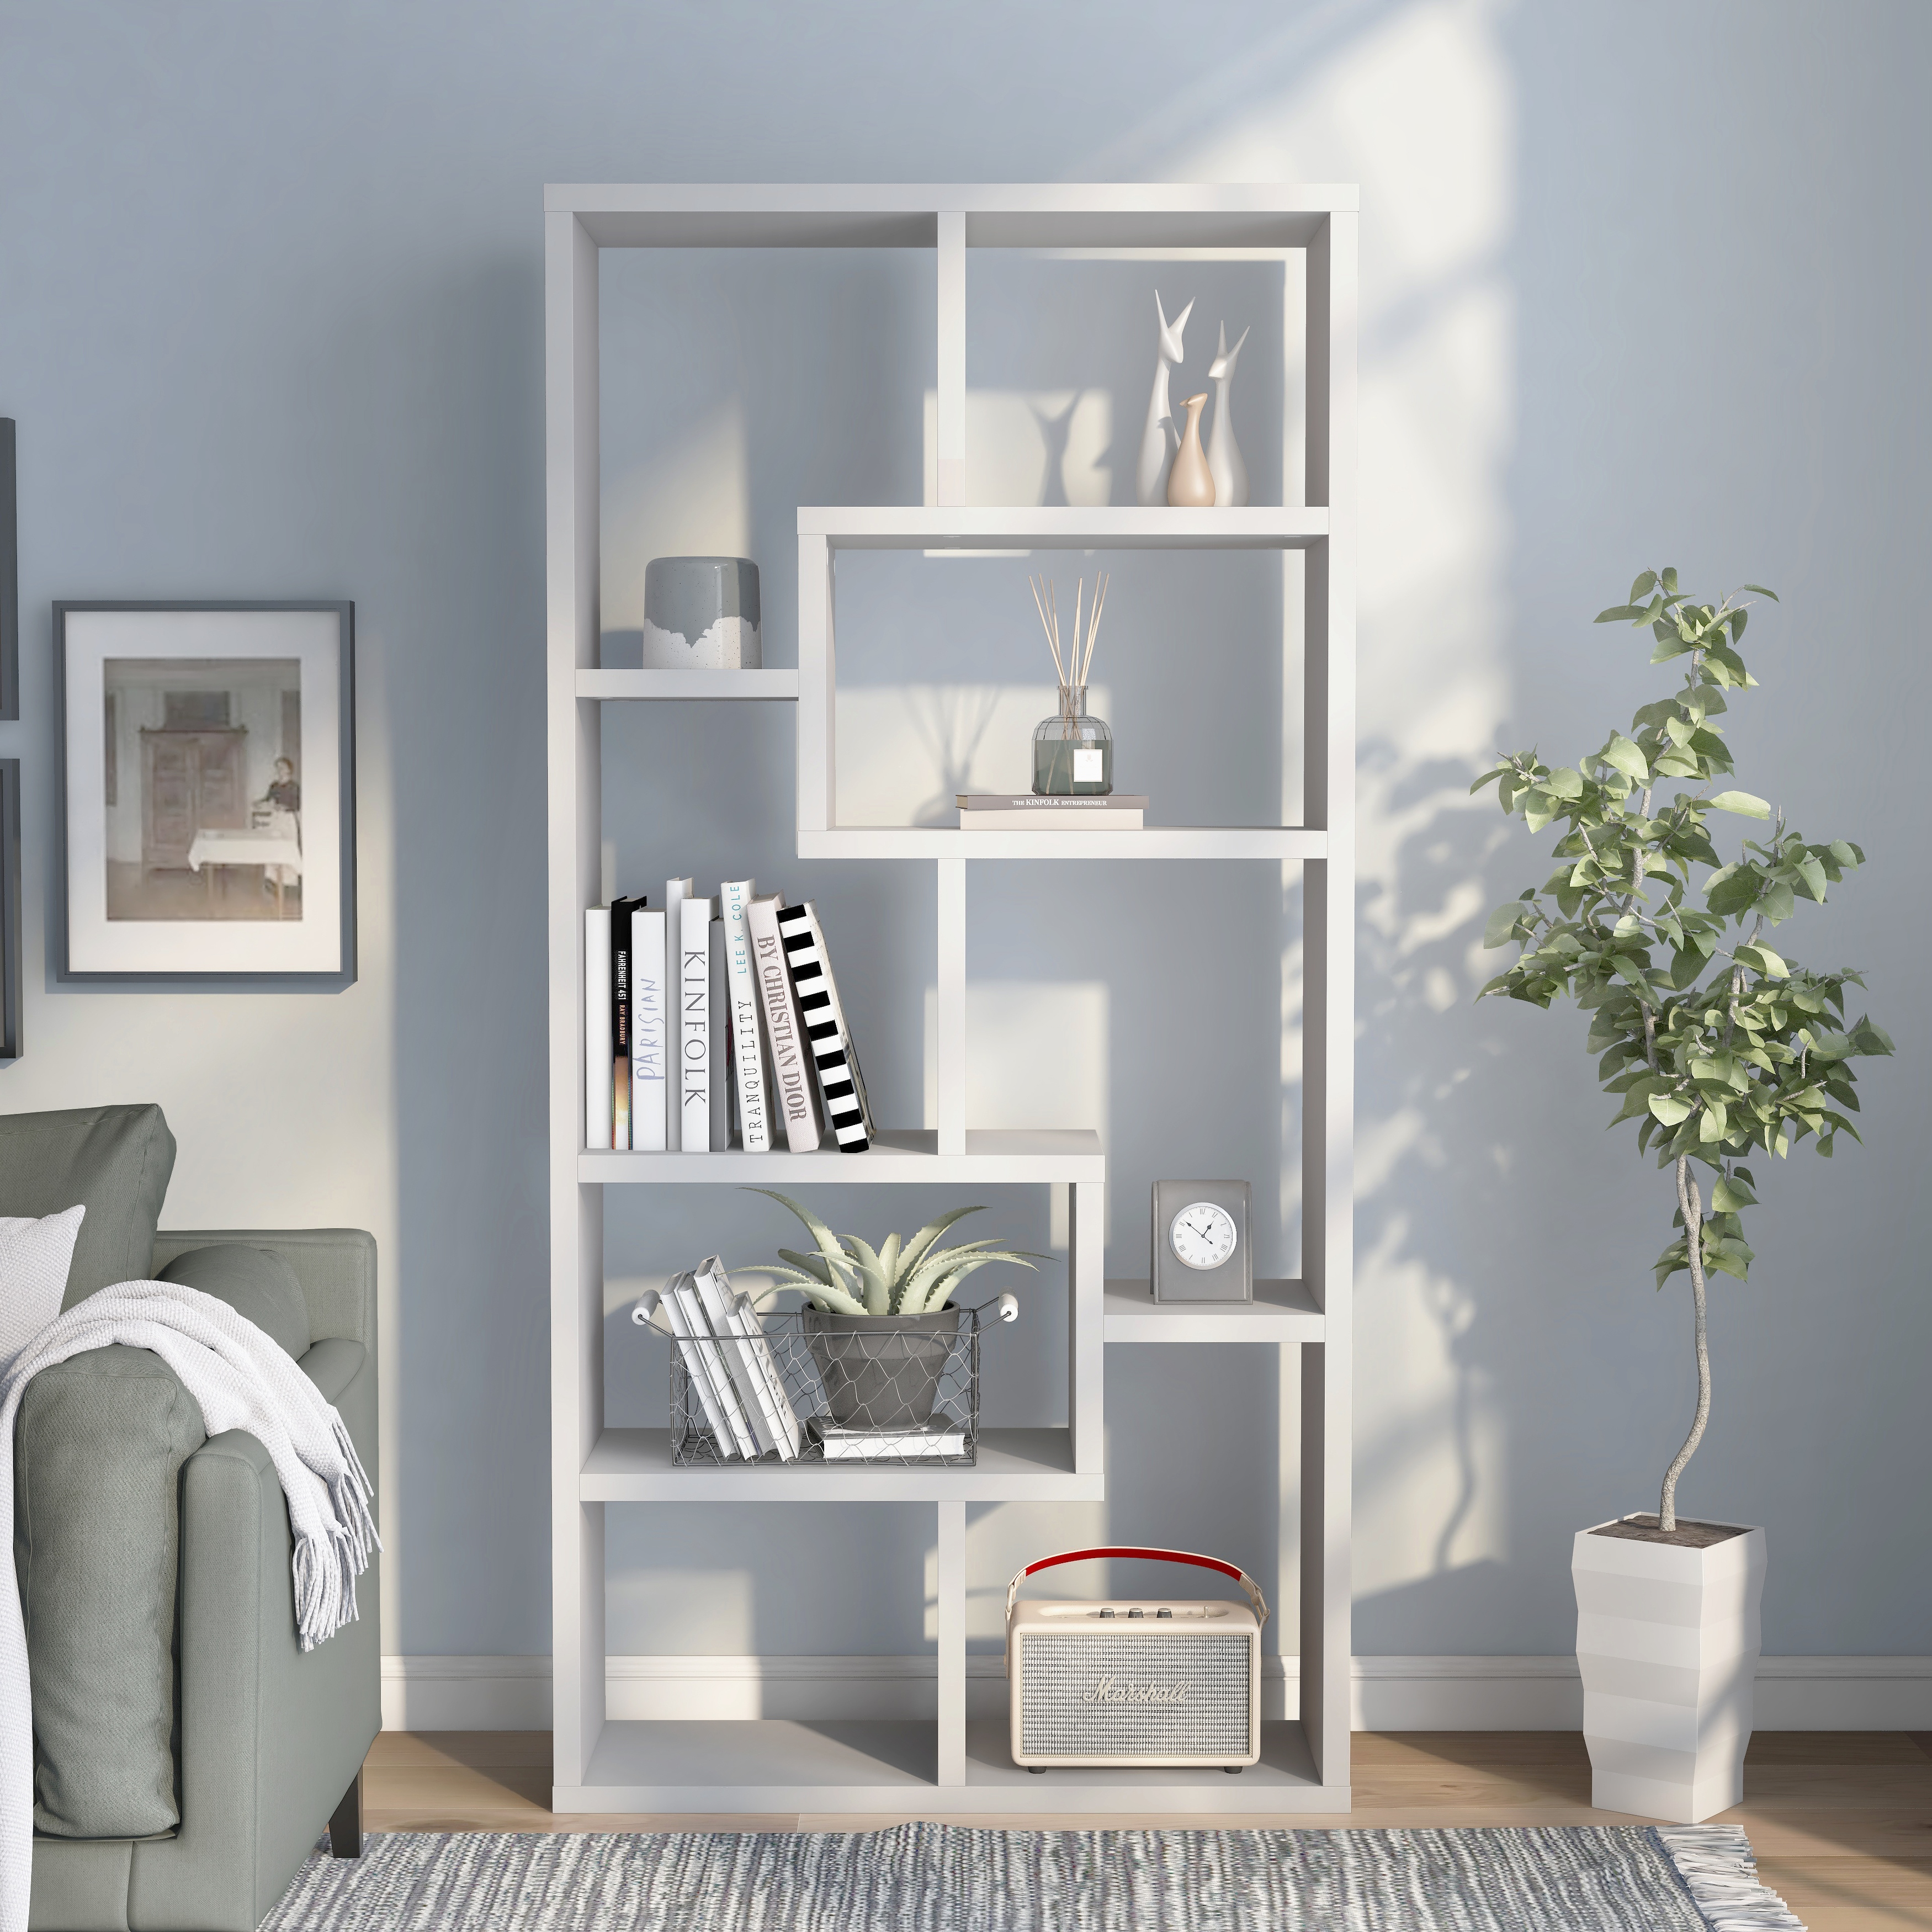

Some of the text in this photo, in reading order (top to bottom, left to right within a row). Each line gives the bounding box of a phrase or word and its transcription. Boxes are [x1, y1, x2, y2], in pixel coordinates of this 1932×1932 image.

[618, 951, 627, 1000] FAHRENHEIT 451
[730, 886, 747, 974] LEE K. COLE
[632, 978, 665, 1080] PARISIAN
[684, 950, 707, 1107] KINFOLK
[738, 1000, 762, 1143] TRANQUILITY
[757, 934, 807, 1123] BY CHRISTIAN DIOR
[1083, 1673, 1192, 1703] Marshall
